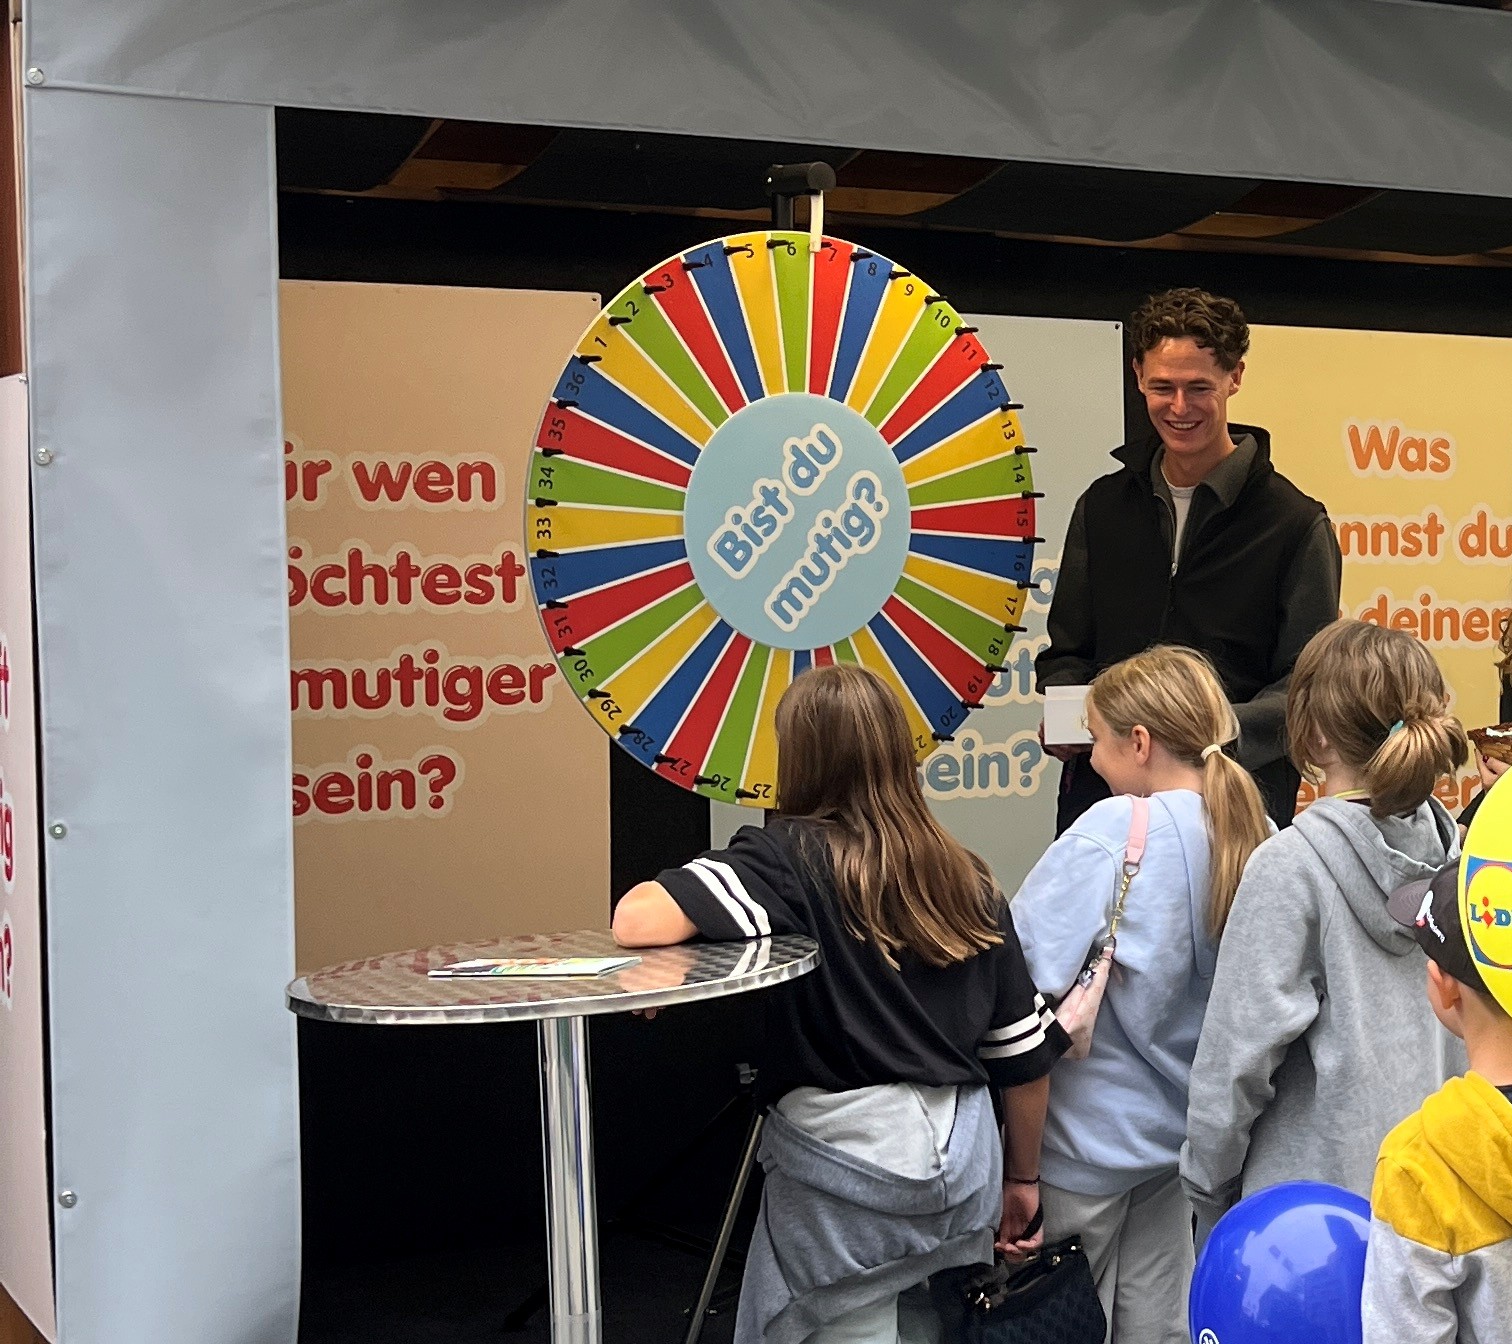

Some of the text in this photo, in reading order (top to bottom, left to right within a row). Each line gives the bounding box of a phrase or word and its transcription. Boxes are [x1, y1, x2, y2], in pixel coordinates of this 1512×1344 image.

[745, 243, 755, 259] 5
[787, 241, 797, 256] 6
[829, 247, 838, 262] 7
[703, 253, 714, 268] 4
[867, 262, 878, 276] 8
[661, 273, 675, 289] 3
[904, 283, 915, 296] 9
[625, 300, 640, 317] 2
[933, 308, 951, 329] 10
[594, 335, 608, 348] 1
[961, 341, 978, 361] 11
[565, 371, 585, 396] 36
[984, 378, 1000, 401] 12
[547, 418, 566, 442] 35
[1001, 420, 1016, 441] 13
[1347, 424, 1452, 474] Was
[351, 460, 497, 504] wen
[538, 466, 556, 490] 34
[1012, 464, 1026, 484] 14
[713, 430, 837, 573] Bist du
[536, 517, 552, 540] 33
[1016, 509, 1029, 528] 15
[1331, 512, 1445, 558] nnst
[770, 477, 888, 625] mutig?
[1013, 552, 1027, 572] 16
[541, 565, 558, 590] 32
[1004, 596, 1018, 616] 17
[553, 615, 573, 639] 31
[987, 637, 1004, 656] 18
[574, 658, 595, 683] 30
[290, 648, 557, 723] mutiger
[967, 674, 983, 694] 19
[600, 698, 623, 721] 29
[940, 705, 958, 727] 20
[632, 730, 655, 753] 28
[669, 757, 692, 776] 27
[917, 736, 1043, 792] ein?
[710, 773, 731, 792] 26
[752, 783, 773, 800] 25
